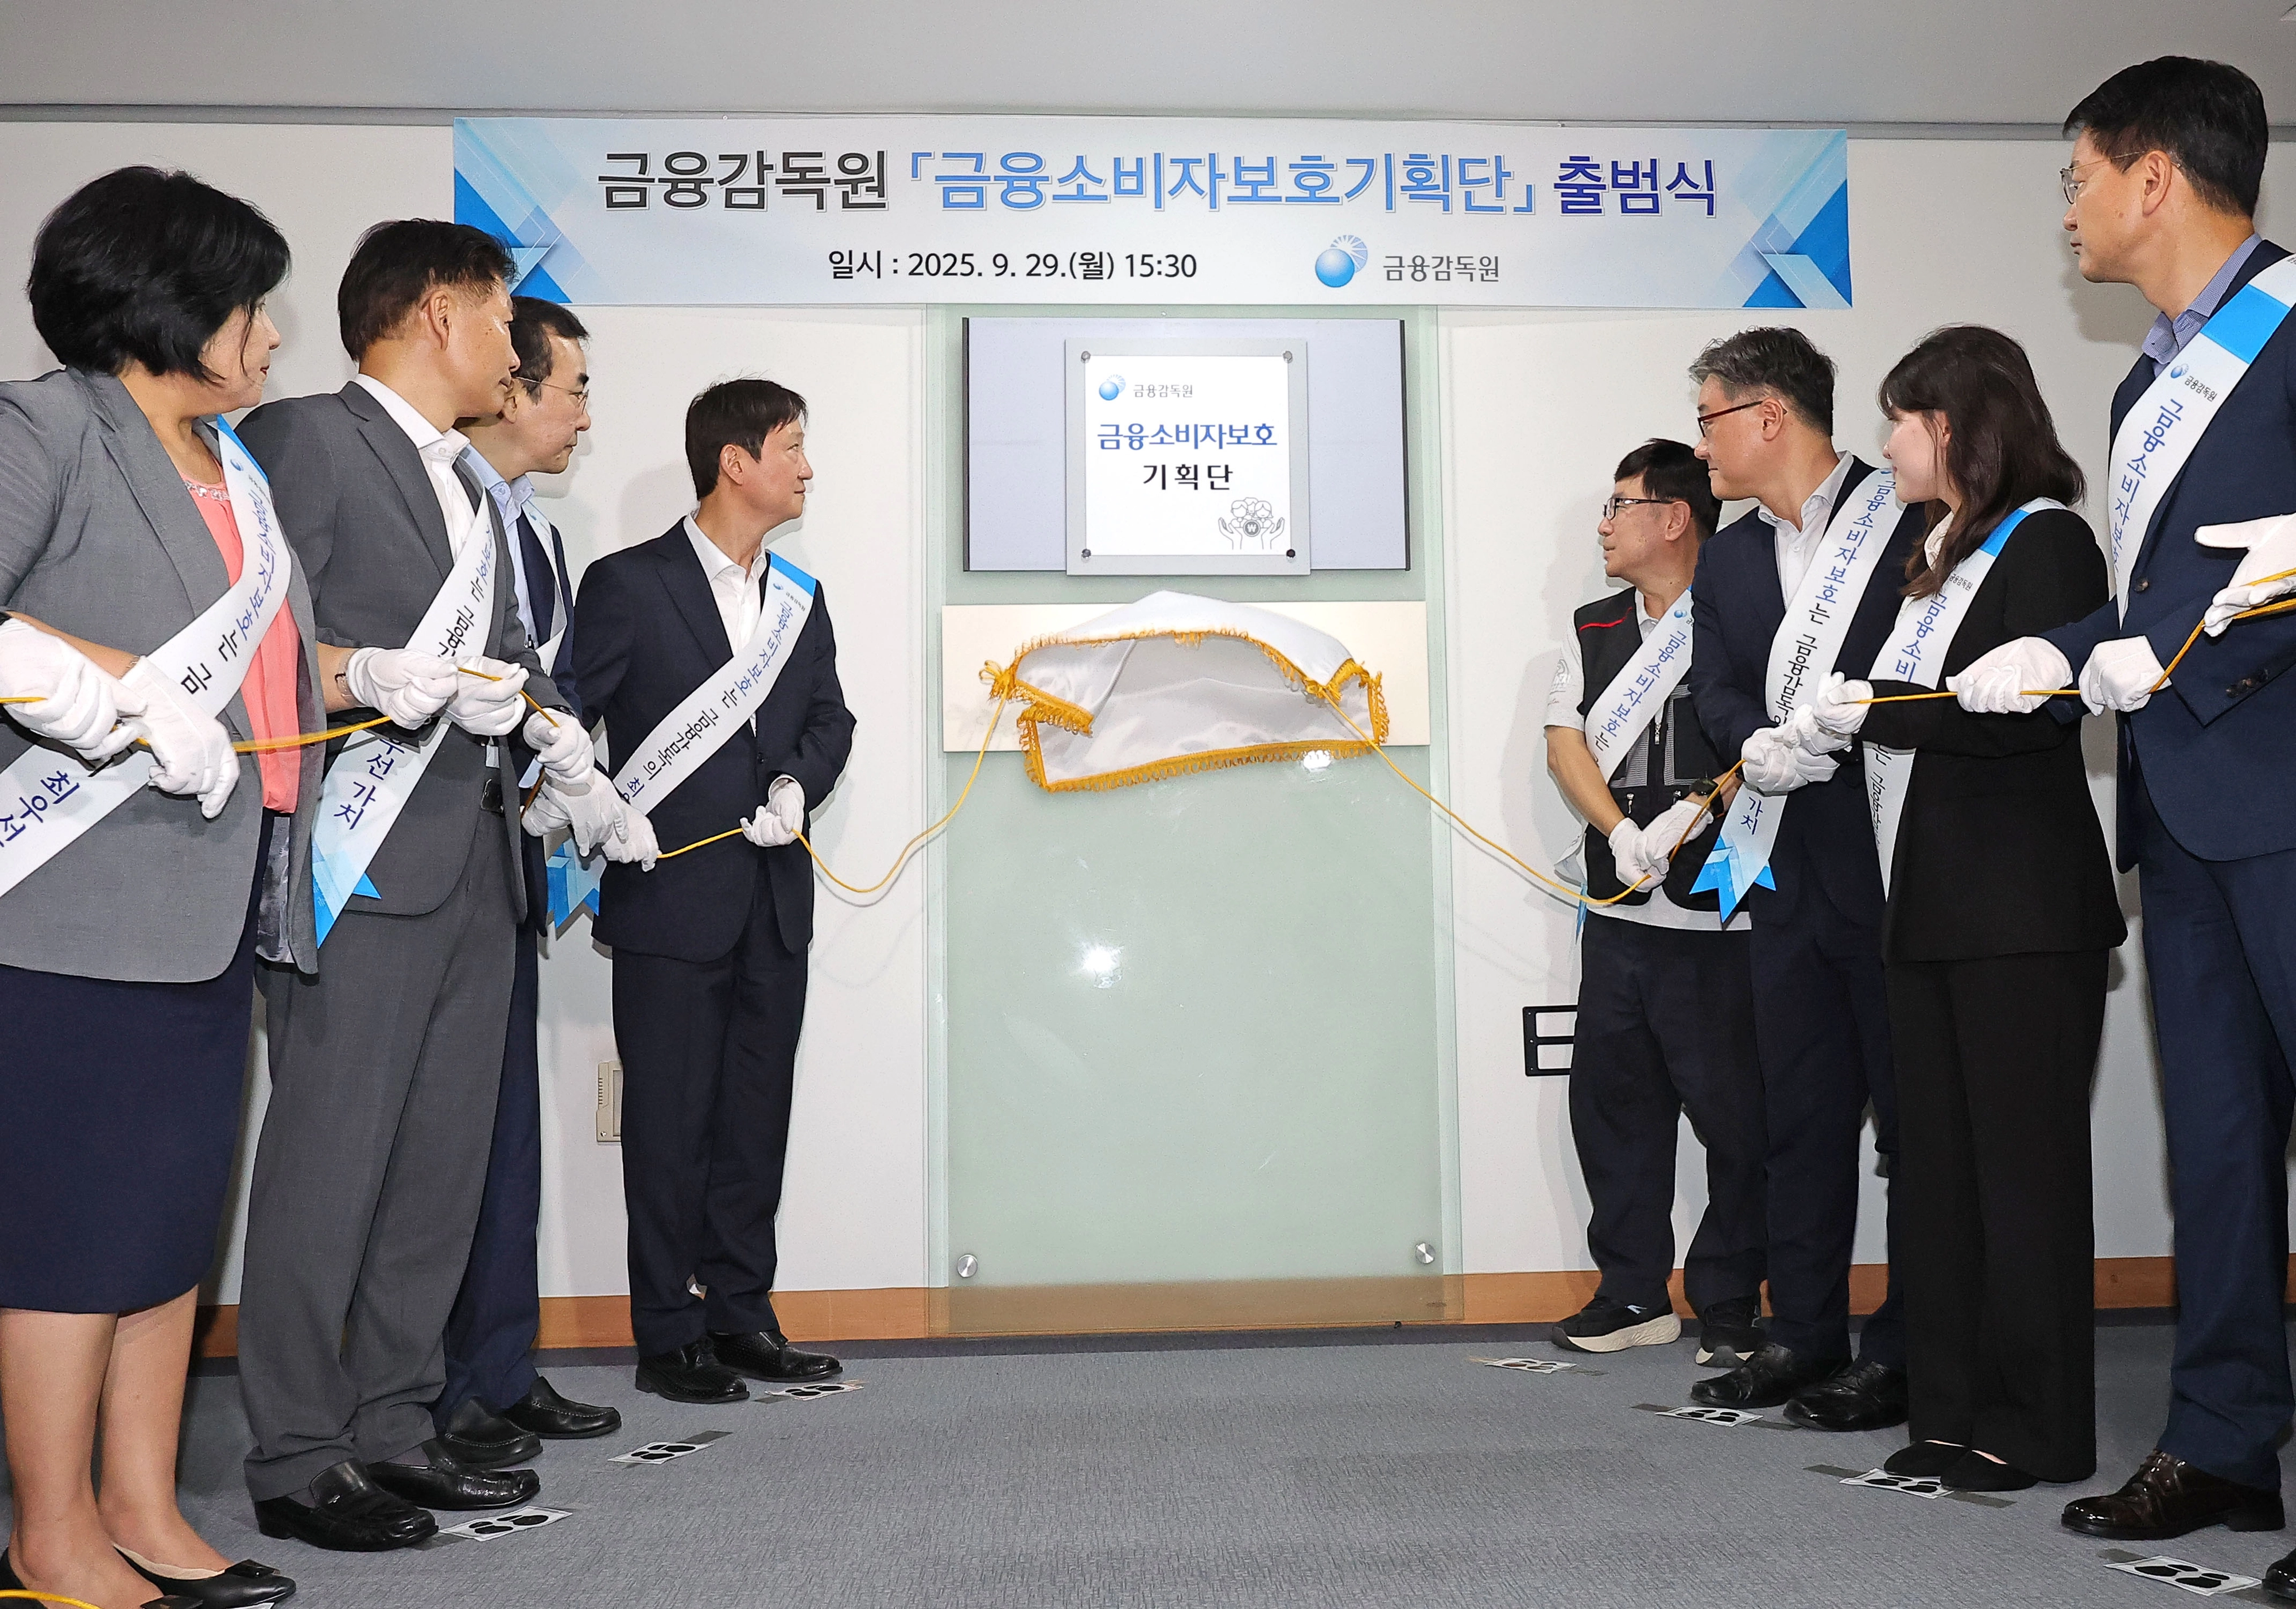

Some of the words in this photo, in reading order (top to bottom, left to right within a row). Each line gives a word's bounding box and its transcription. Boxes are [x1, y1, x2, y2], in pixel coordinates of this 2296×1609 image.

[598, 150, 888, 214] 금융감독원
[910, 151, 1537, 216] 「금융소비자보호기획단」
[1553, 156, 1718, 219] 출범식
[829, 250, 881, 279] 일시
[908, 253, 982, 277] 2025.
[992, 253, 1016, 277] 9.
[1025, 251, 1114, 280] 29.(월)
[1126, 253, 1197, 278] 15:30
[1383, 255, 1499, 282] 금융감독원
[1133, 384, 1193, 398] 금융감독원
[2184, 375, 2218, 402] 금융감독원
[1097, 422, 1278, 451] 금융소비자보호
[1809, 480, 1896, 625] 금융소비자보호는
[722, 600, 793, 709] 금융소비자보호는
[1595, 630, 1687, 751] 금융소비자보호는
[642, 708, 719, 781] 금융감독원의
[333, 781, 377, 831] 가치
[1740, 796, 1764, 836] 가치
